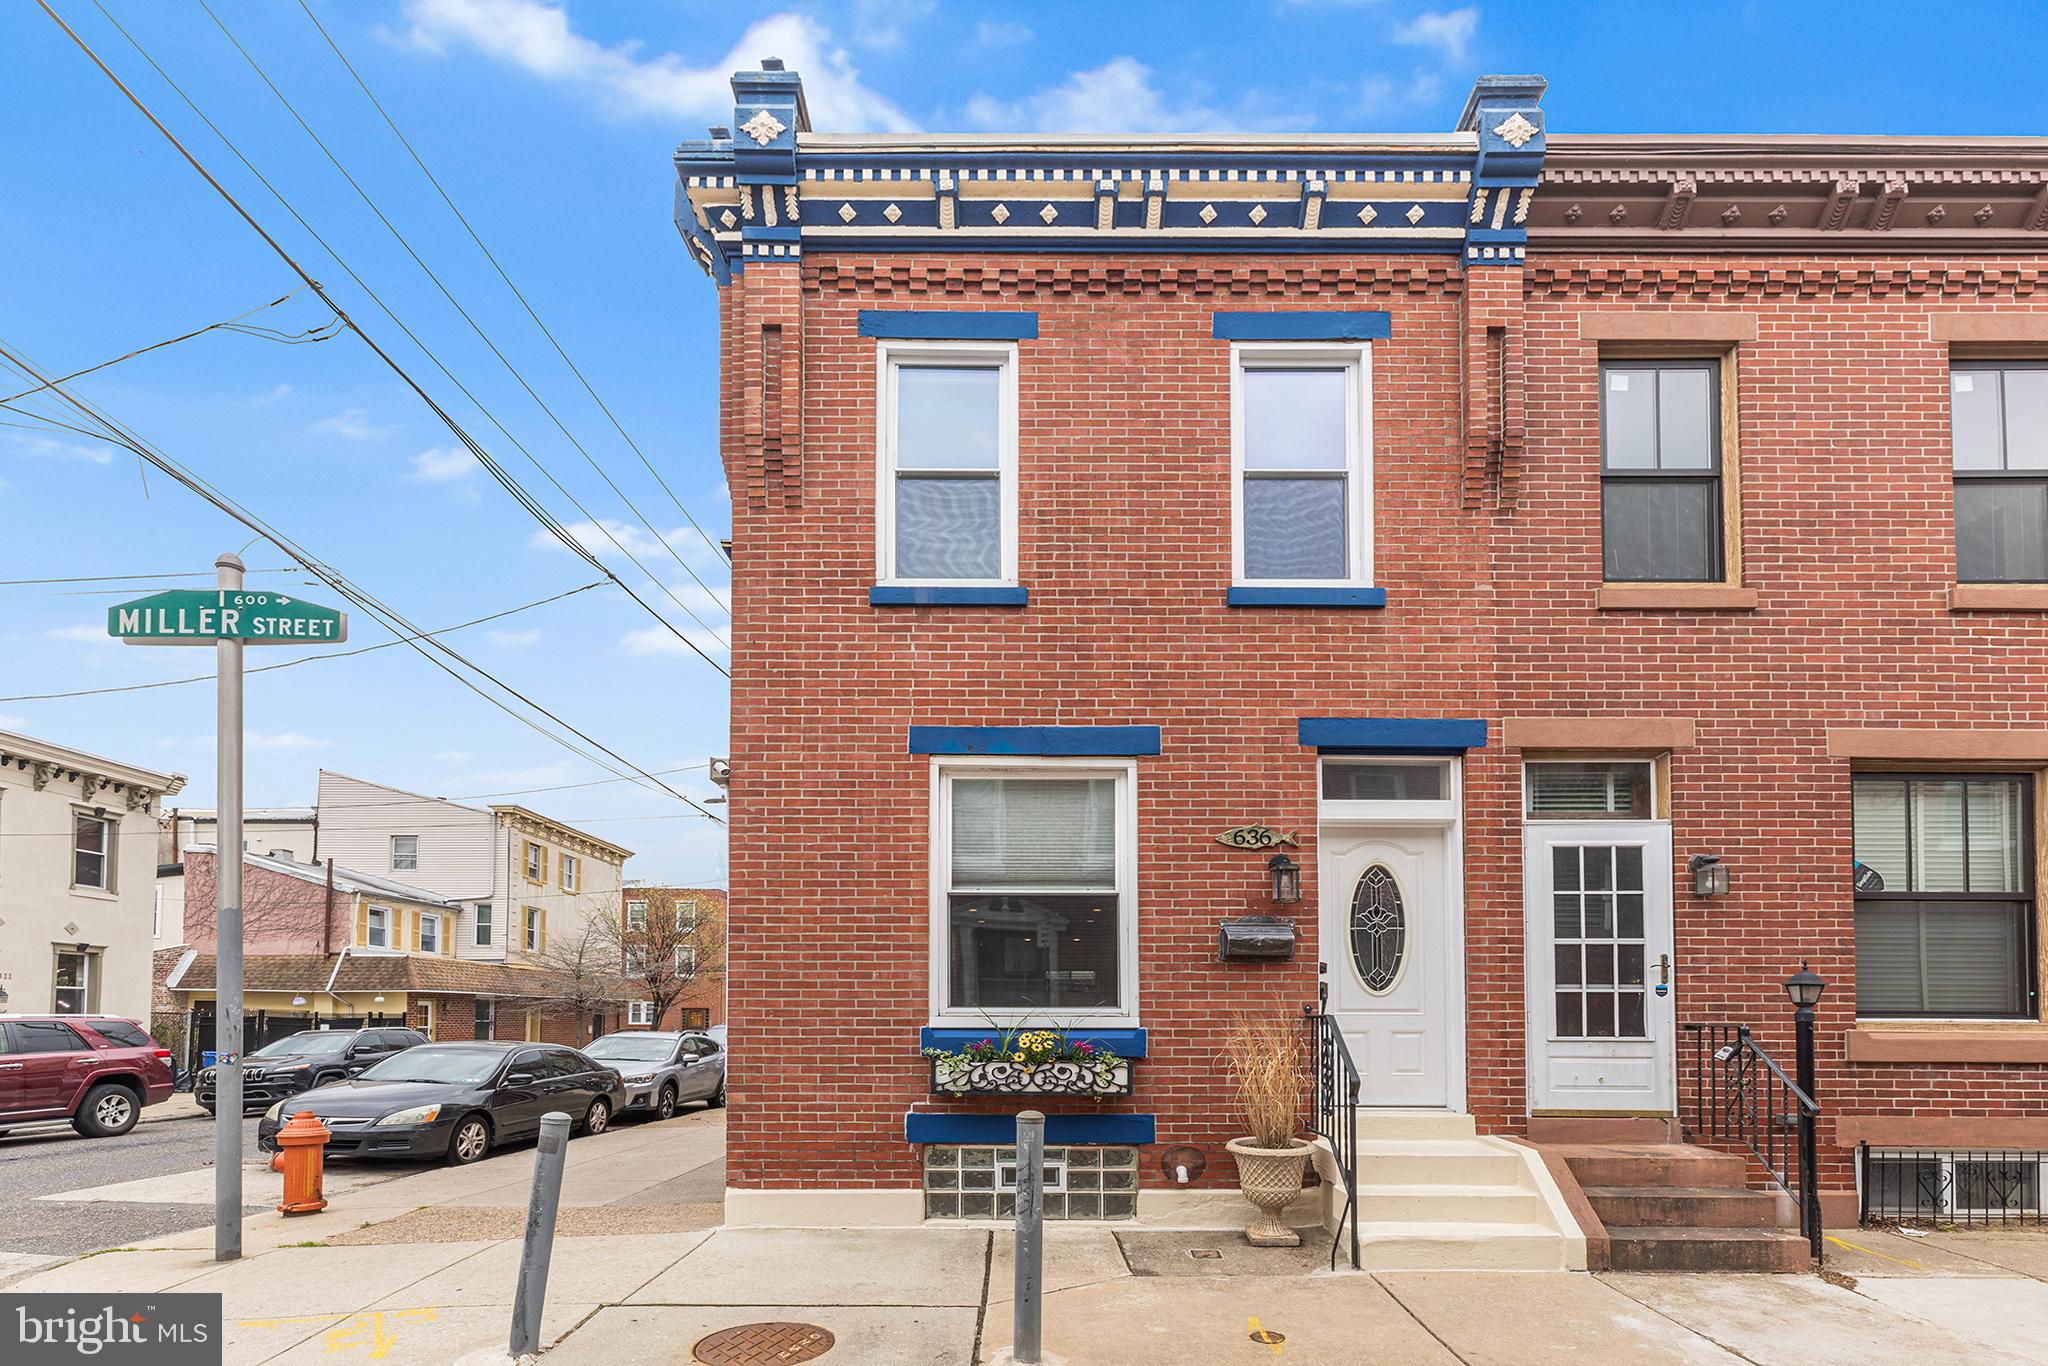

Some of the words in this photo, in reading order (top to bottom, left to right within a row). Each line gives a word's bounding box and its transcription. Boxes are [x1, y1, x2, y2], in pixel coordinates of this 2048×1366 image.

[234, 595, 267, 605] 600
[119, 608, 239, 634] MILLER
[253, 617, 334, 636] STREET
[1234, 829, 1271, 845] 636
